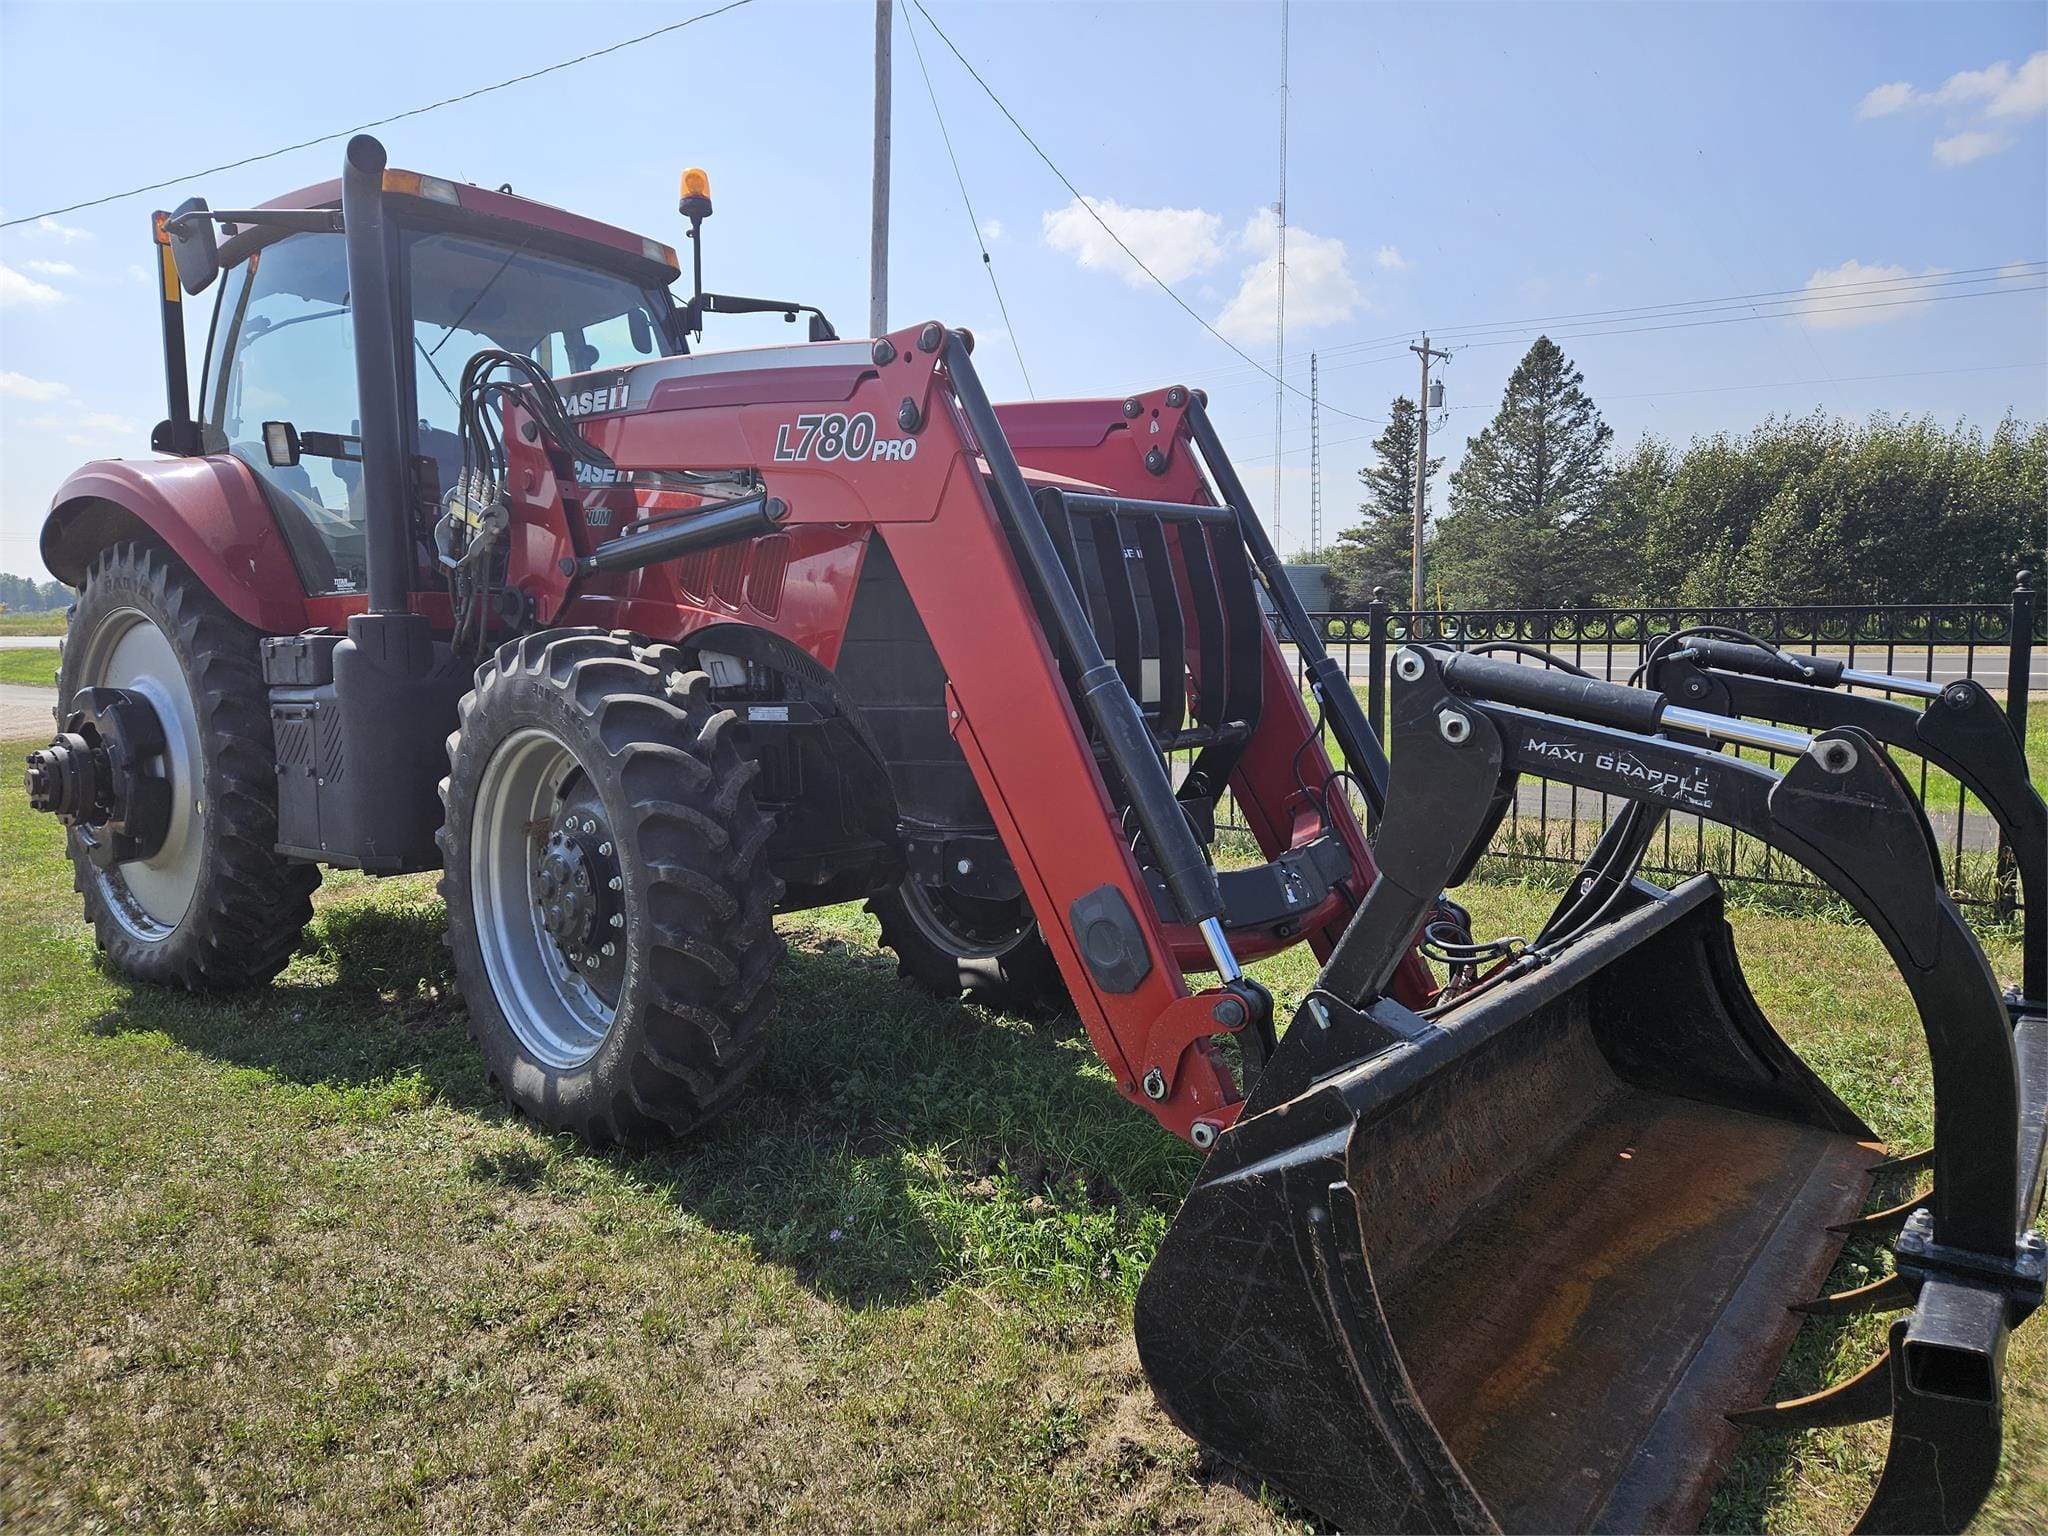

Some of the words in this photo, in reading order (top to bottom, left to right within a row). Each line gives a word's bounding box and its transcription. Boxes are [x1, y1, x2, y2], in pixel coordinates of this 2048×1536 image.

[773, 411, 878, 463] L780
[872, 437, 917, 462] PRO
[586, 509, 612, 526] NUM
[1527, 738, 1584, 764] MAXI
[1596, 755, 1709, 796] GRAPPLE
